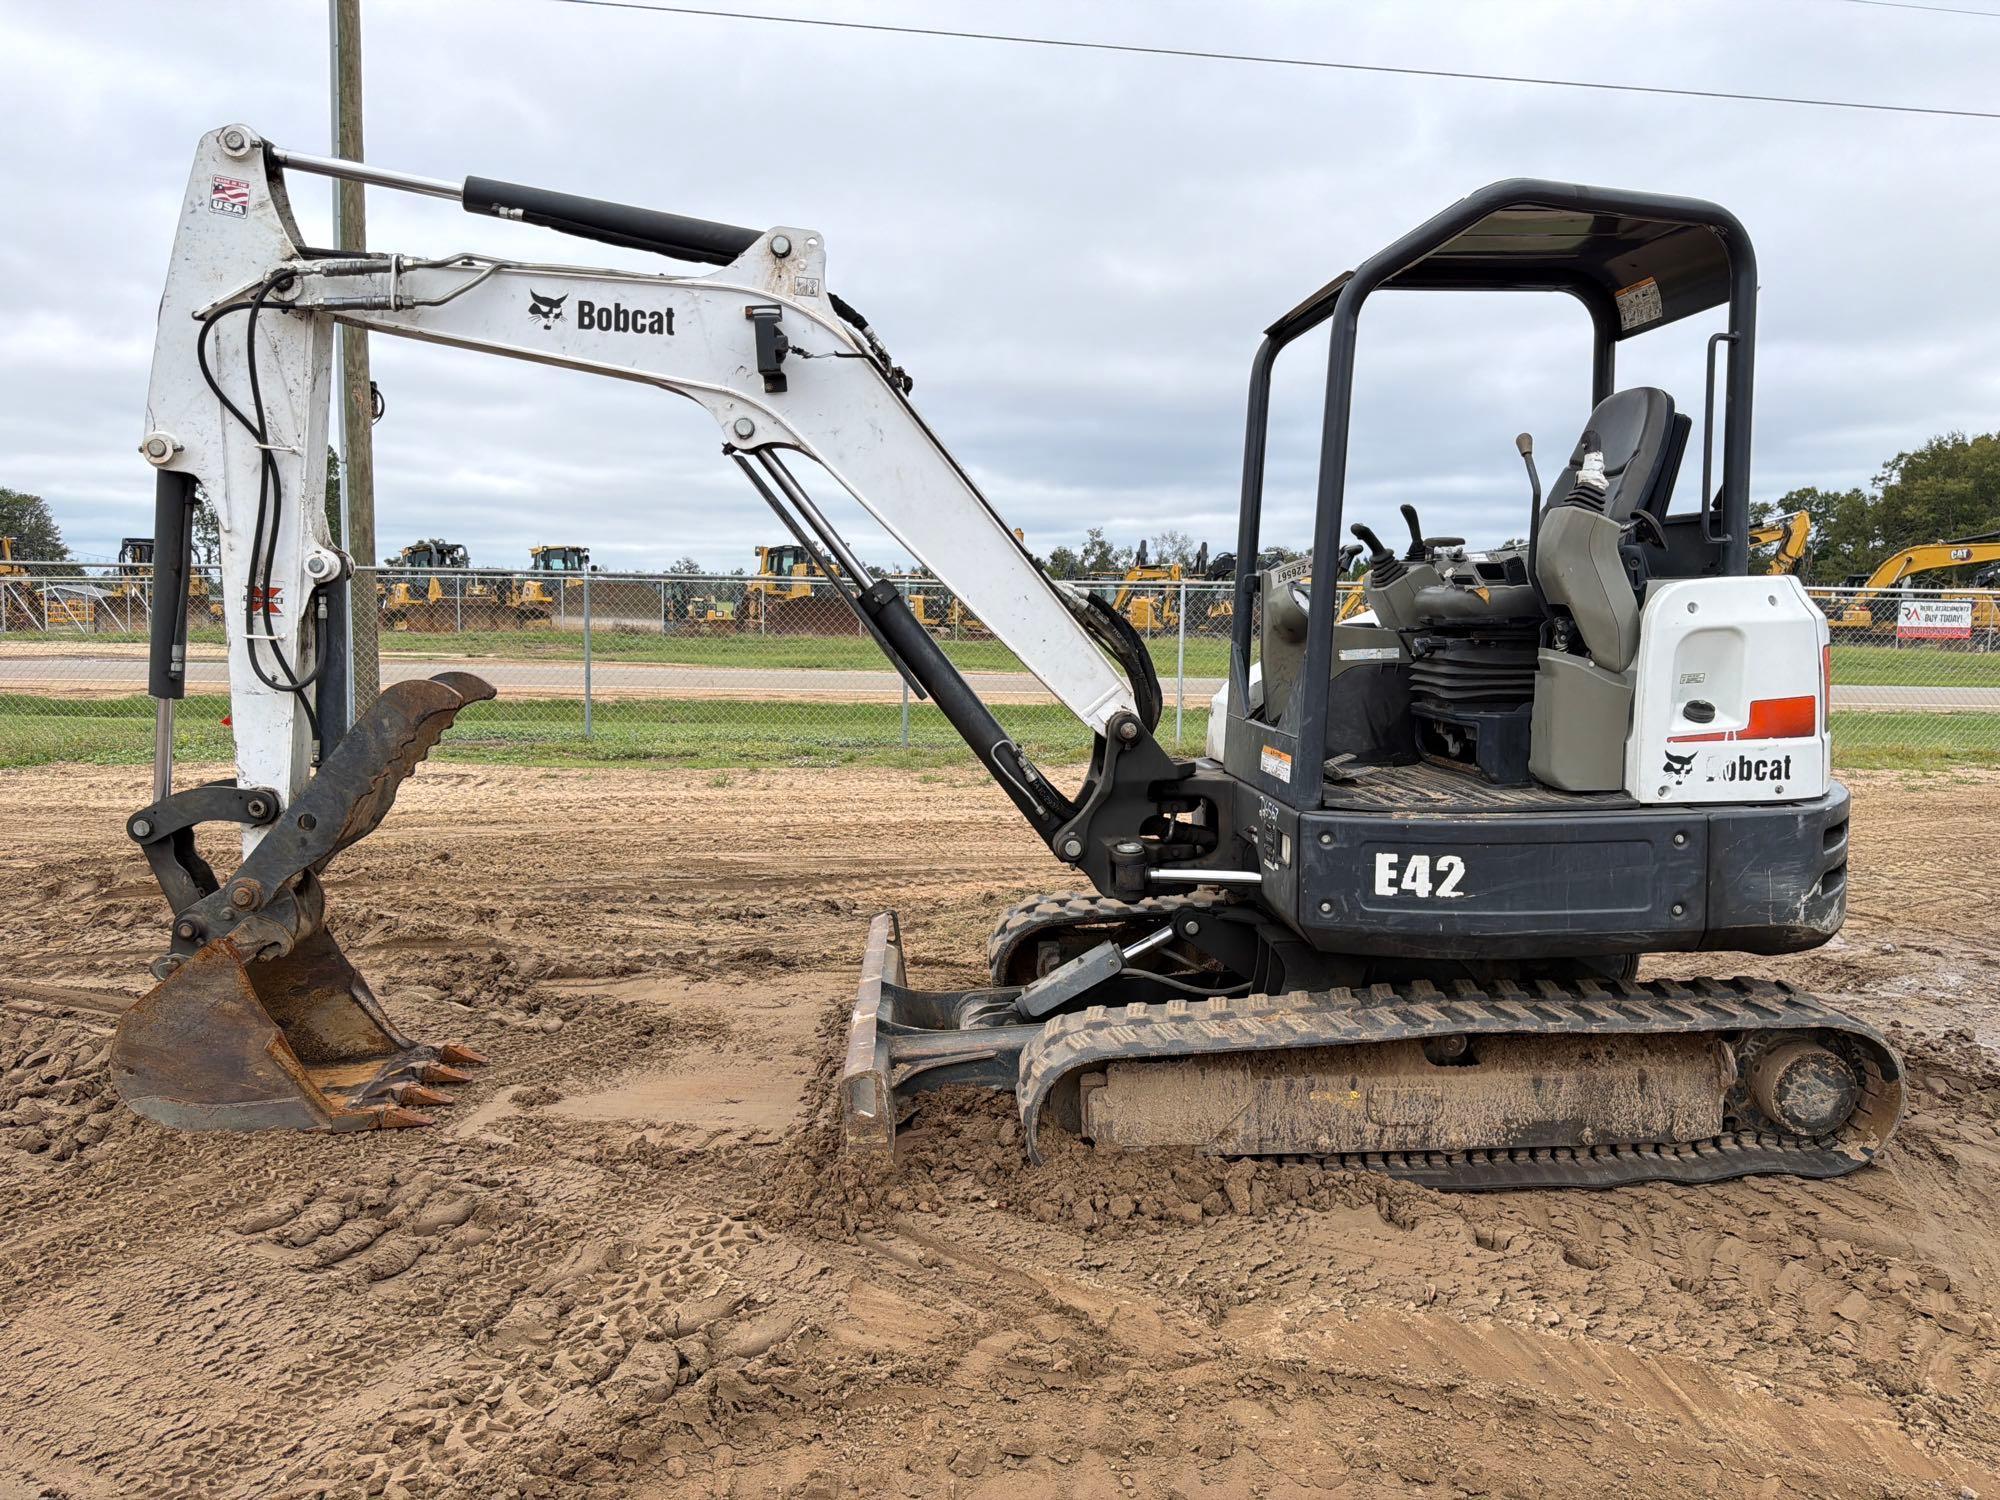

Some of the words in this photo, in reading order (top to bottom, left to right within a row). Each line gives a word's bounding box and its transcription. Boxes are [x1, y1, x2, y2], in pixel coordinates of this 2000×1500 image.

[212, 200, 245, 215] USA
[578, 300, 675, 336] Bobcat
[1951, 549, 1969, 560] CAT
[1277, 564, 1307, 584] 226567
[1925, 614, 1938, 622] BUY
[1940, 614, 1963, 623] TODAY!
[1706, 755, 1791, 782] obcat
[1375, 853, 1466, 898] E42
